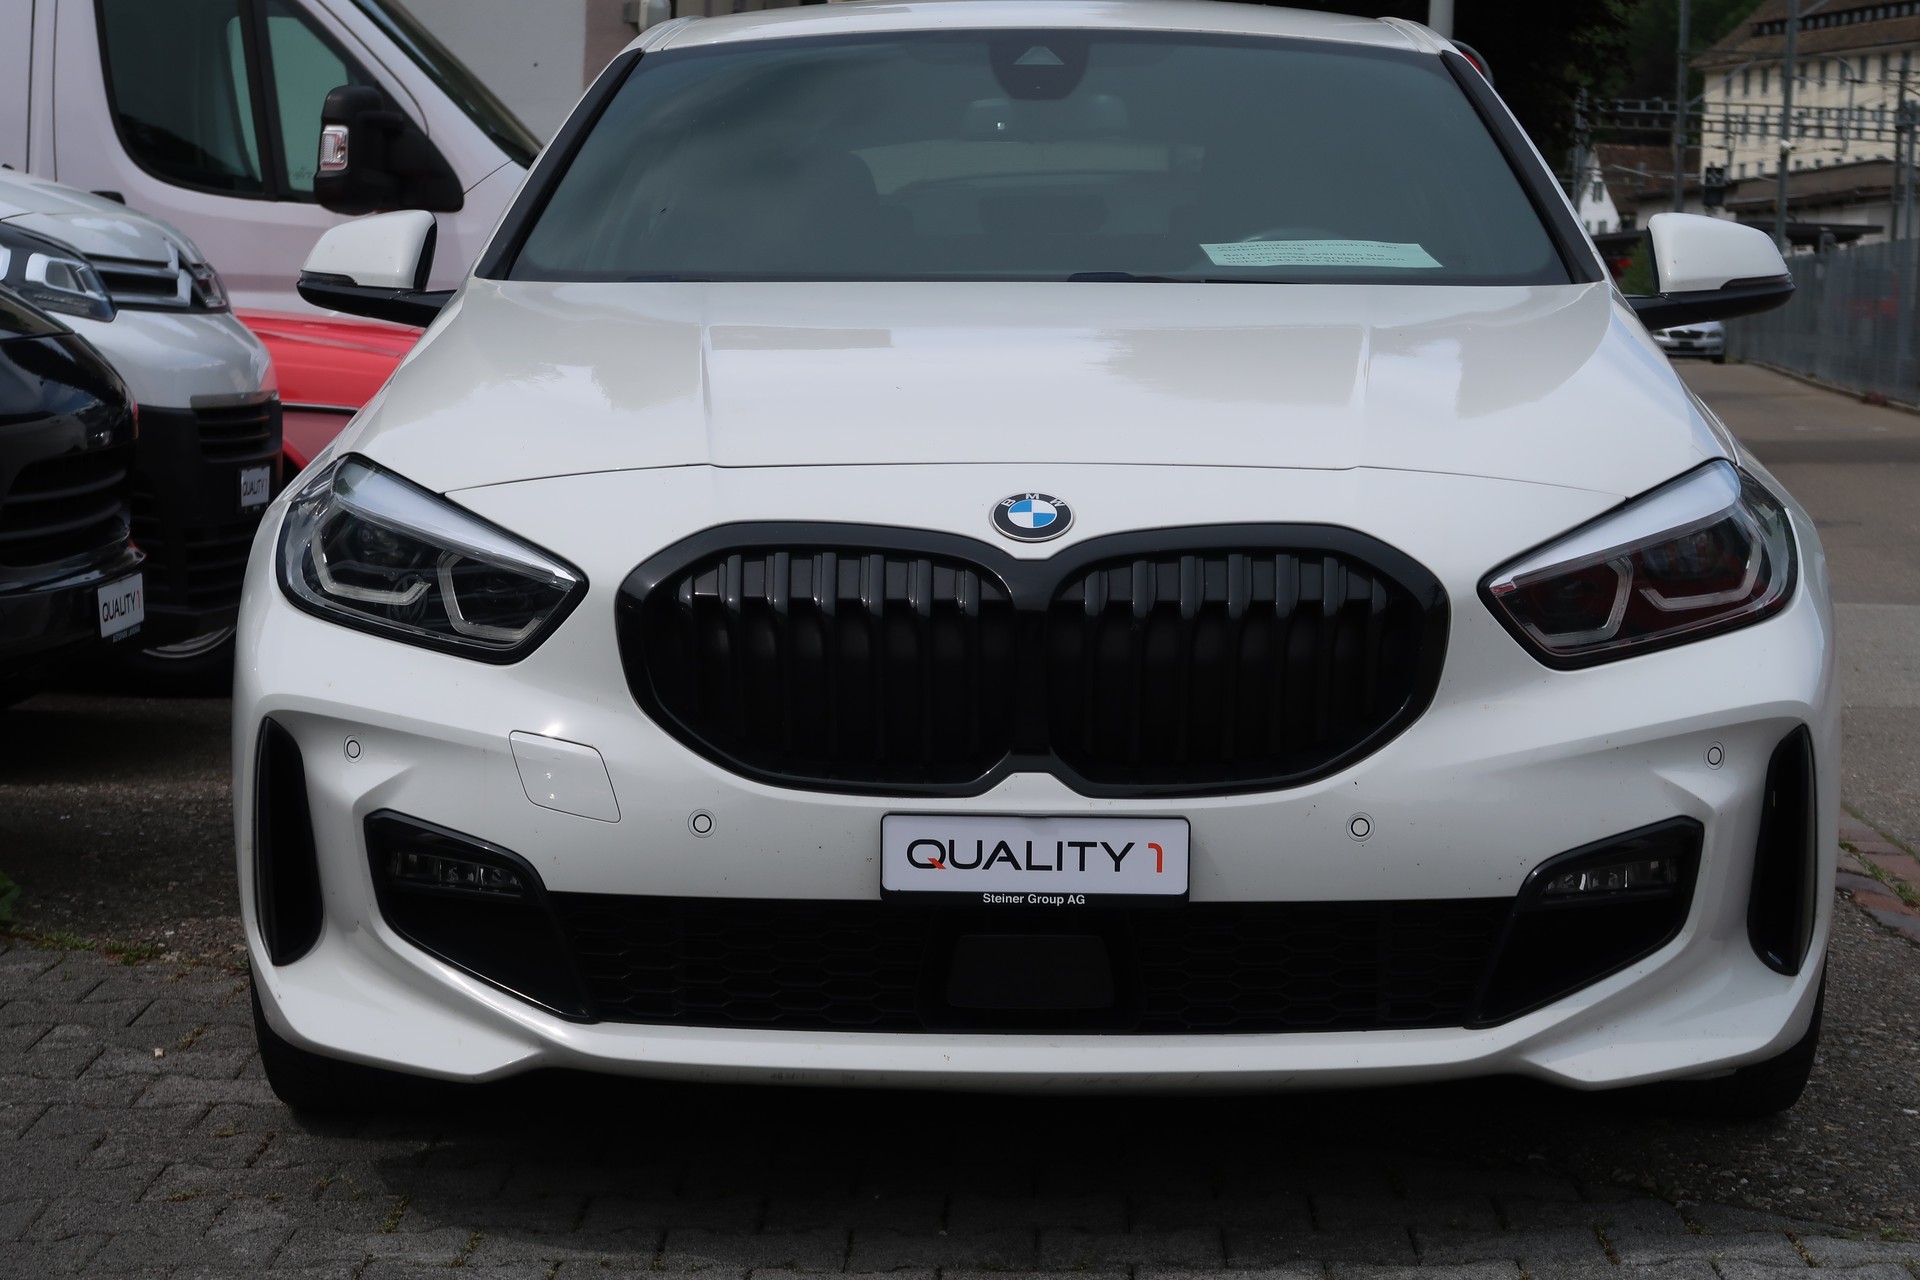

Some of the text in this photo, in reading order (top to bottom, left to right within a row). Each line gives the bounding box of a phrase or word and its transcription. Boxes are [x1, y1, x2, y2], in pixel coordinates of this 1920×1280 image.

[102, 591, 136, 623] QUALITY
[906, 838, 1163, 873] QUALITY 1
[982, 892, 1086, 906] Steiner Group AG
